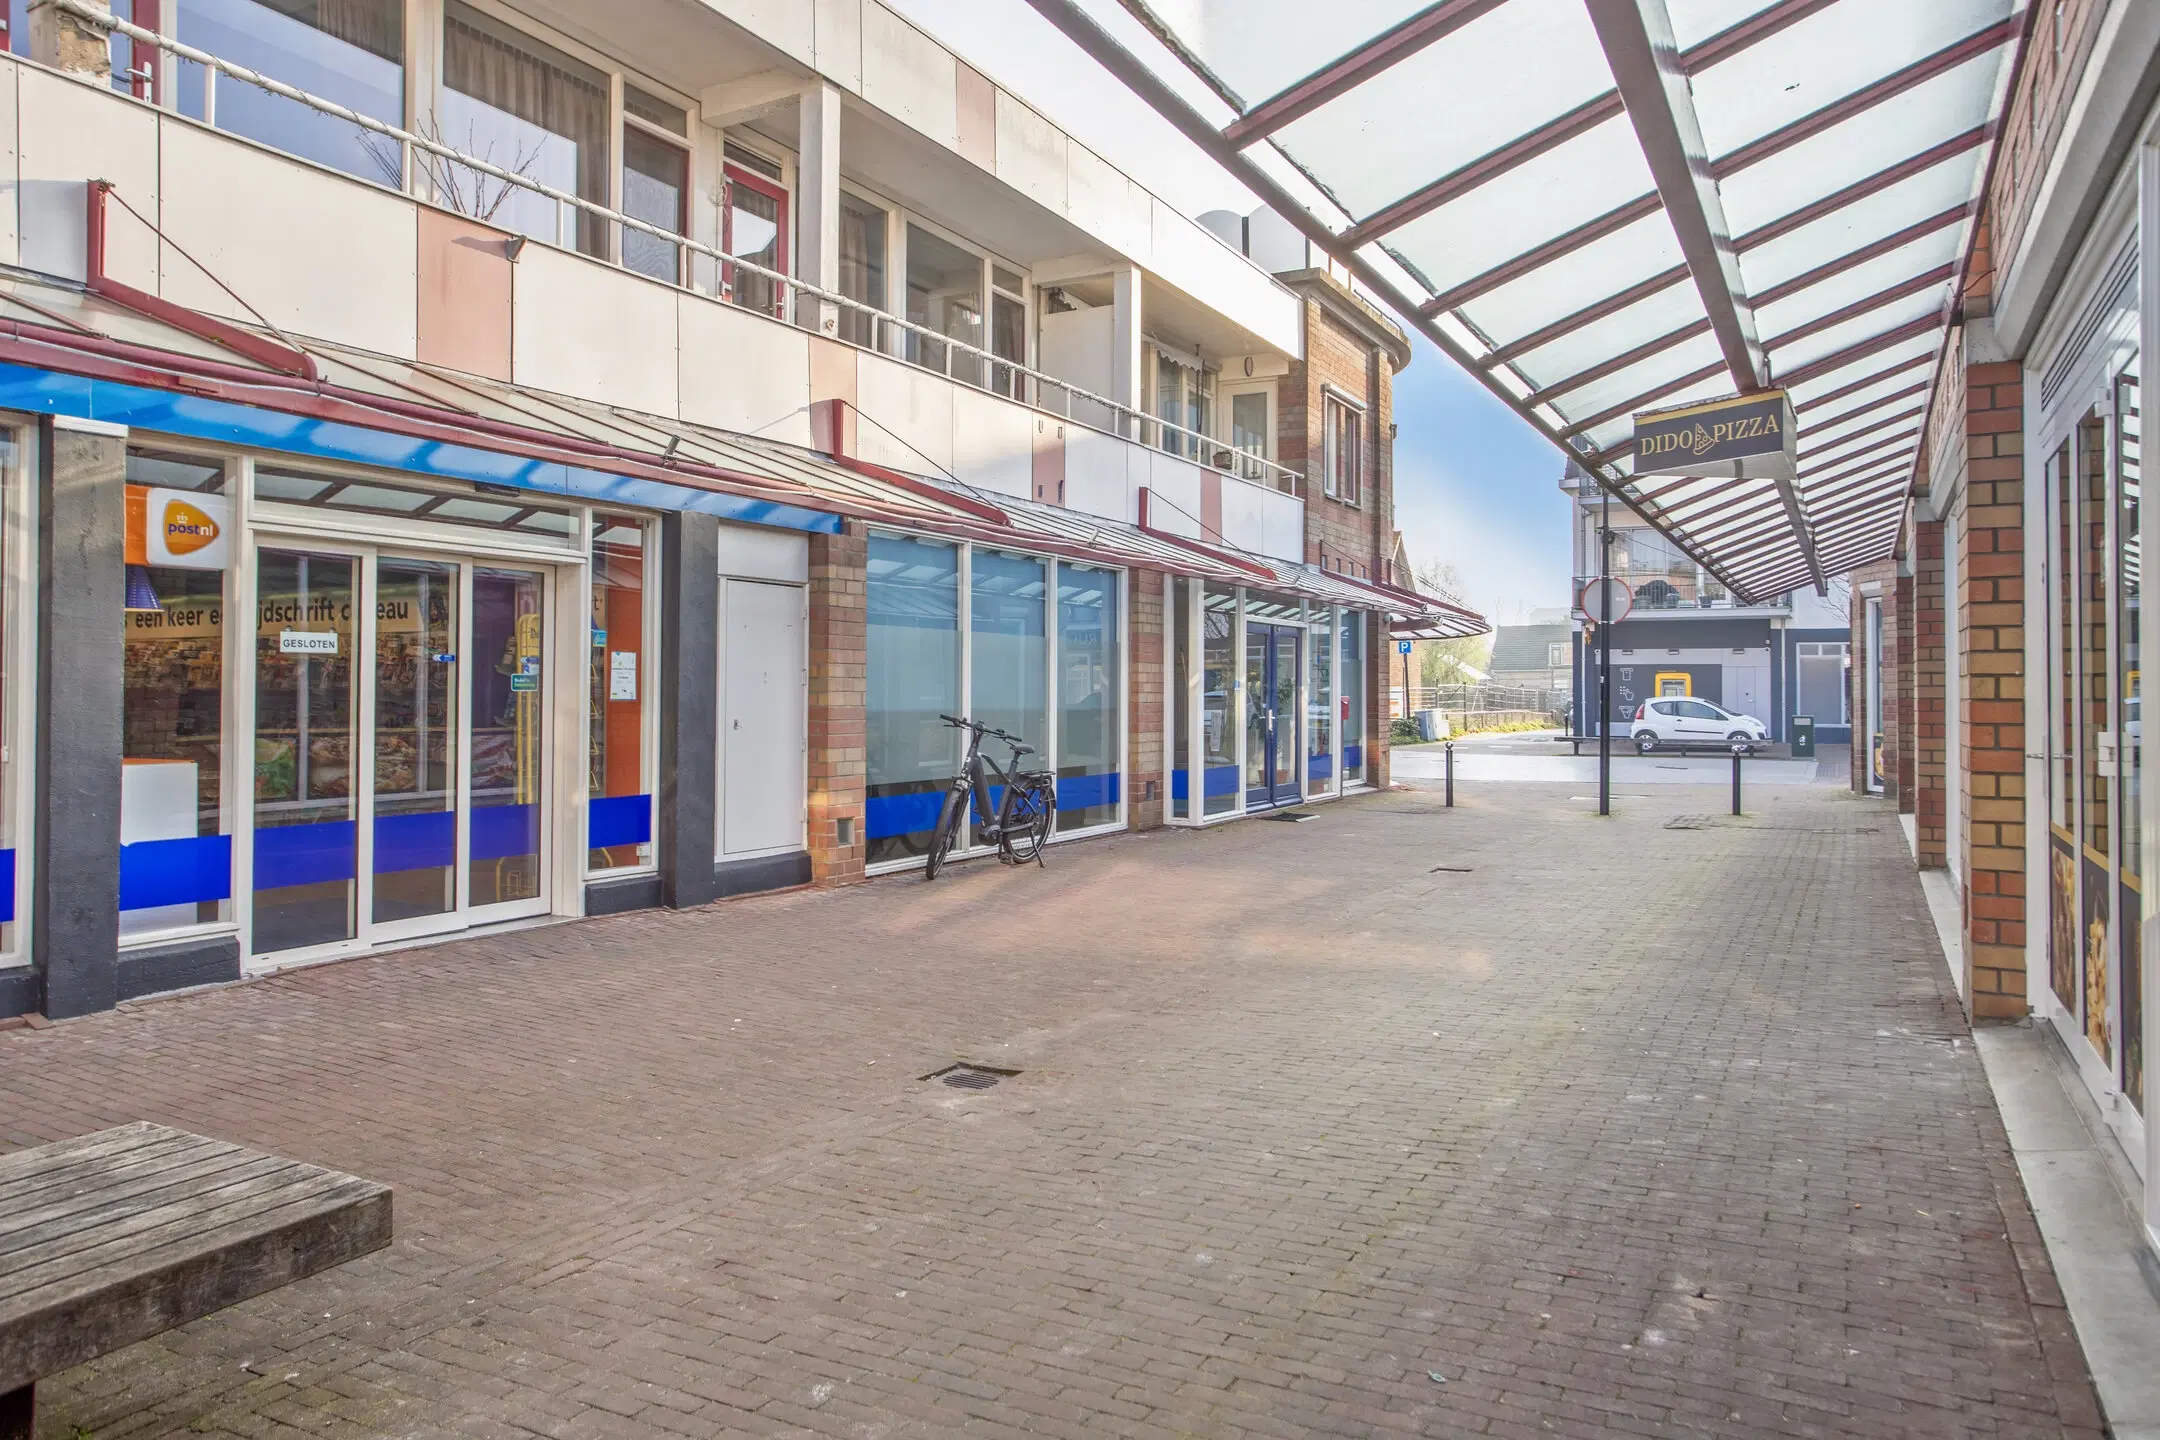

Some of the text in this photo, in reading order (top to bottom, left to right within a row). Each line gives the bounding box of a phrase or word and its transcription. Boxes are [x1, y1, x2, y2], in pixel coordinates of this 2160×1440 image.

[1641, 414, 1780, 456] DIDO PIZZA
[168, 523, 213, 537] postnl
[135, 612, 162, 628] een
[167, 604, 204, 627] keer
[256, 597, 334, 630] jdschrift
[282, 638, 336, 649] GESLOTEN
[1401, 642, 1409, 652] P
